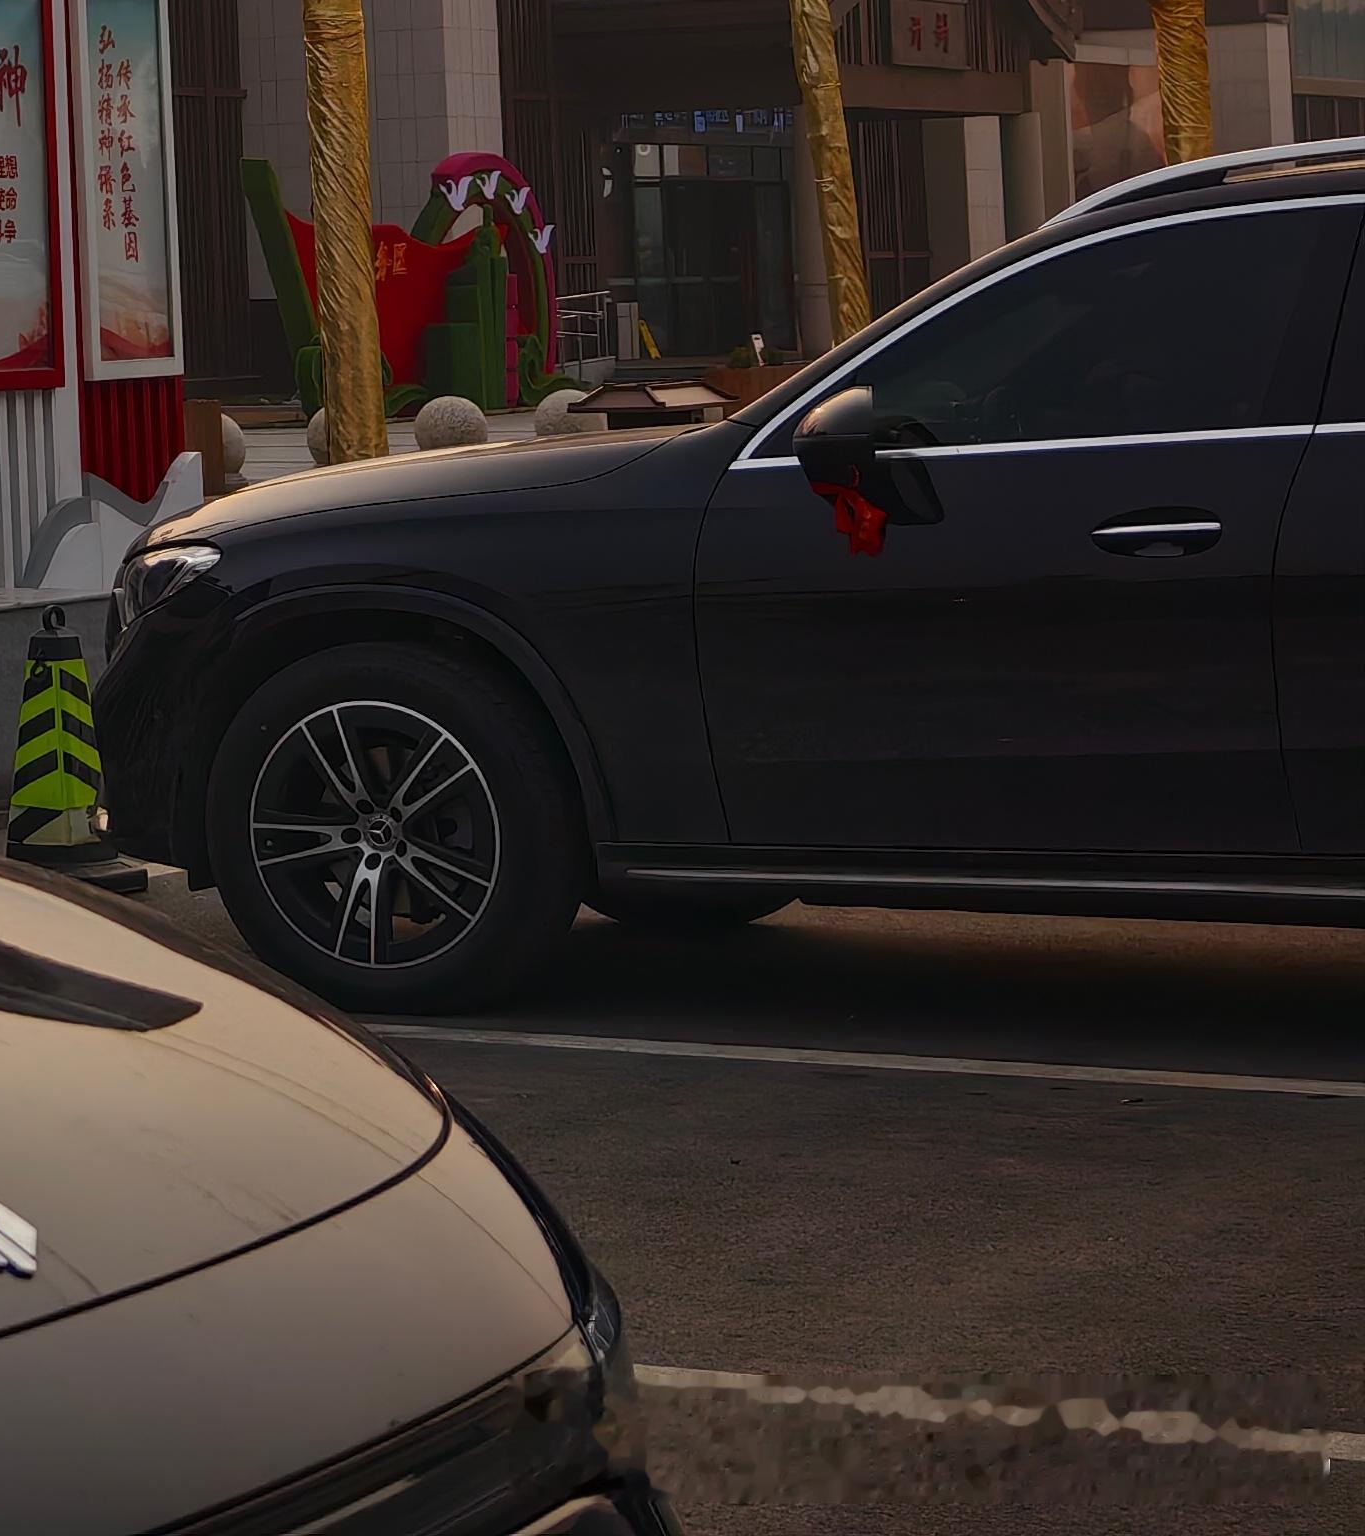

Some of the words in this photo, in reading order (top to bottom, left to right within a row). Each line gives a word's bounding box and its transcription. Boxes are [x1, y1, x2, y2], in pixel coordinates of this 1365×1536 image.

[116, 59, 140, 264] 传承红色基因
